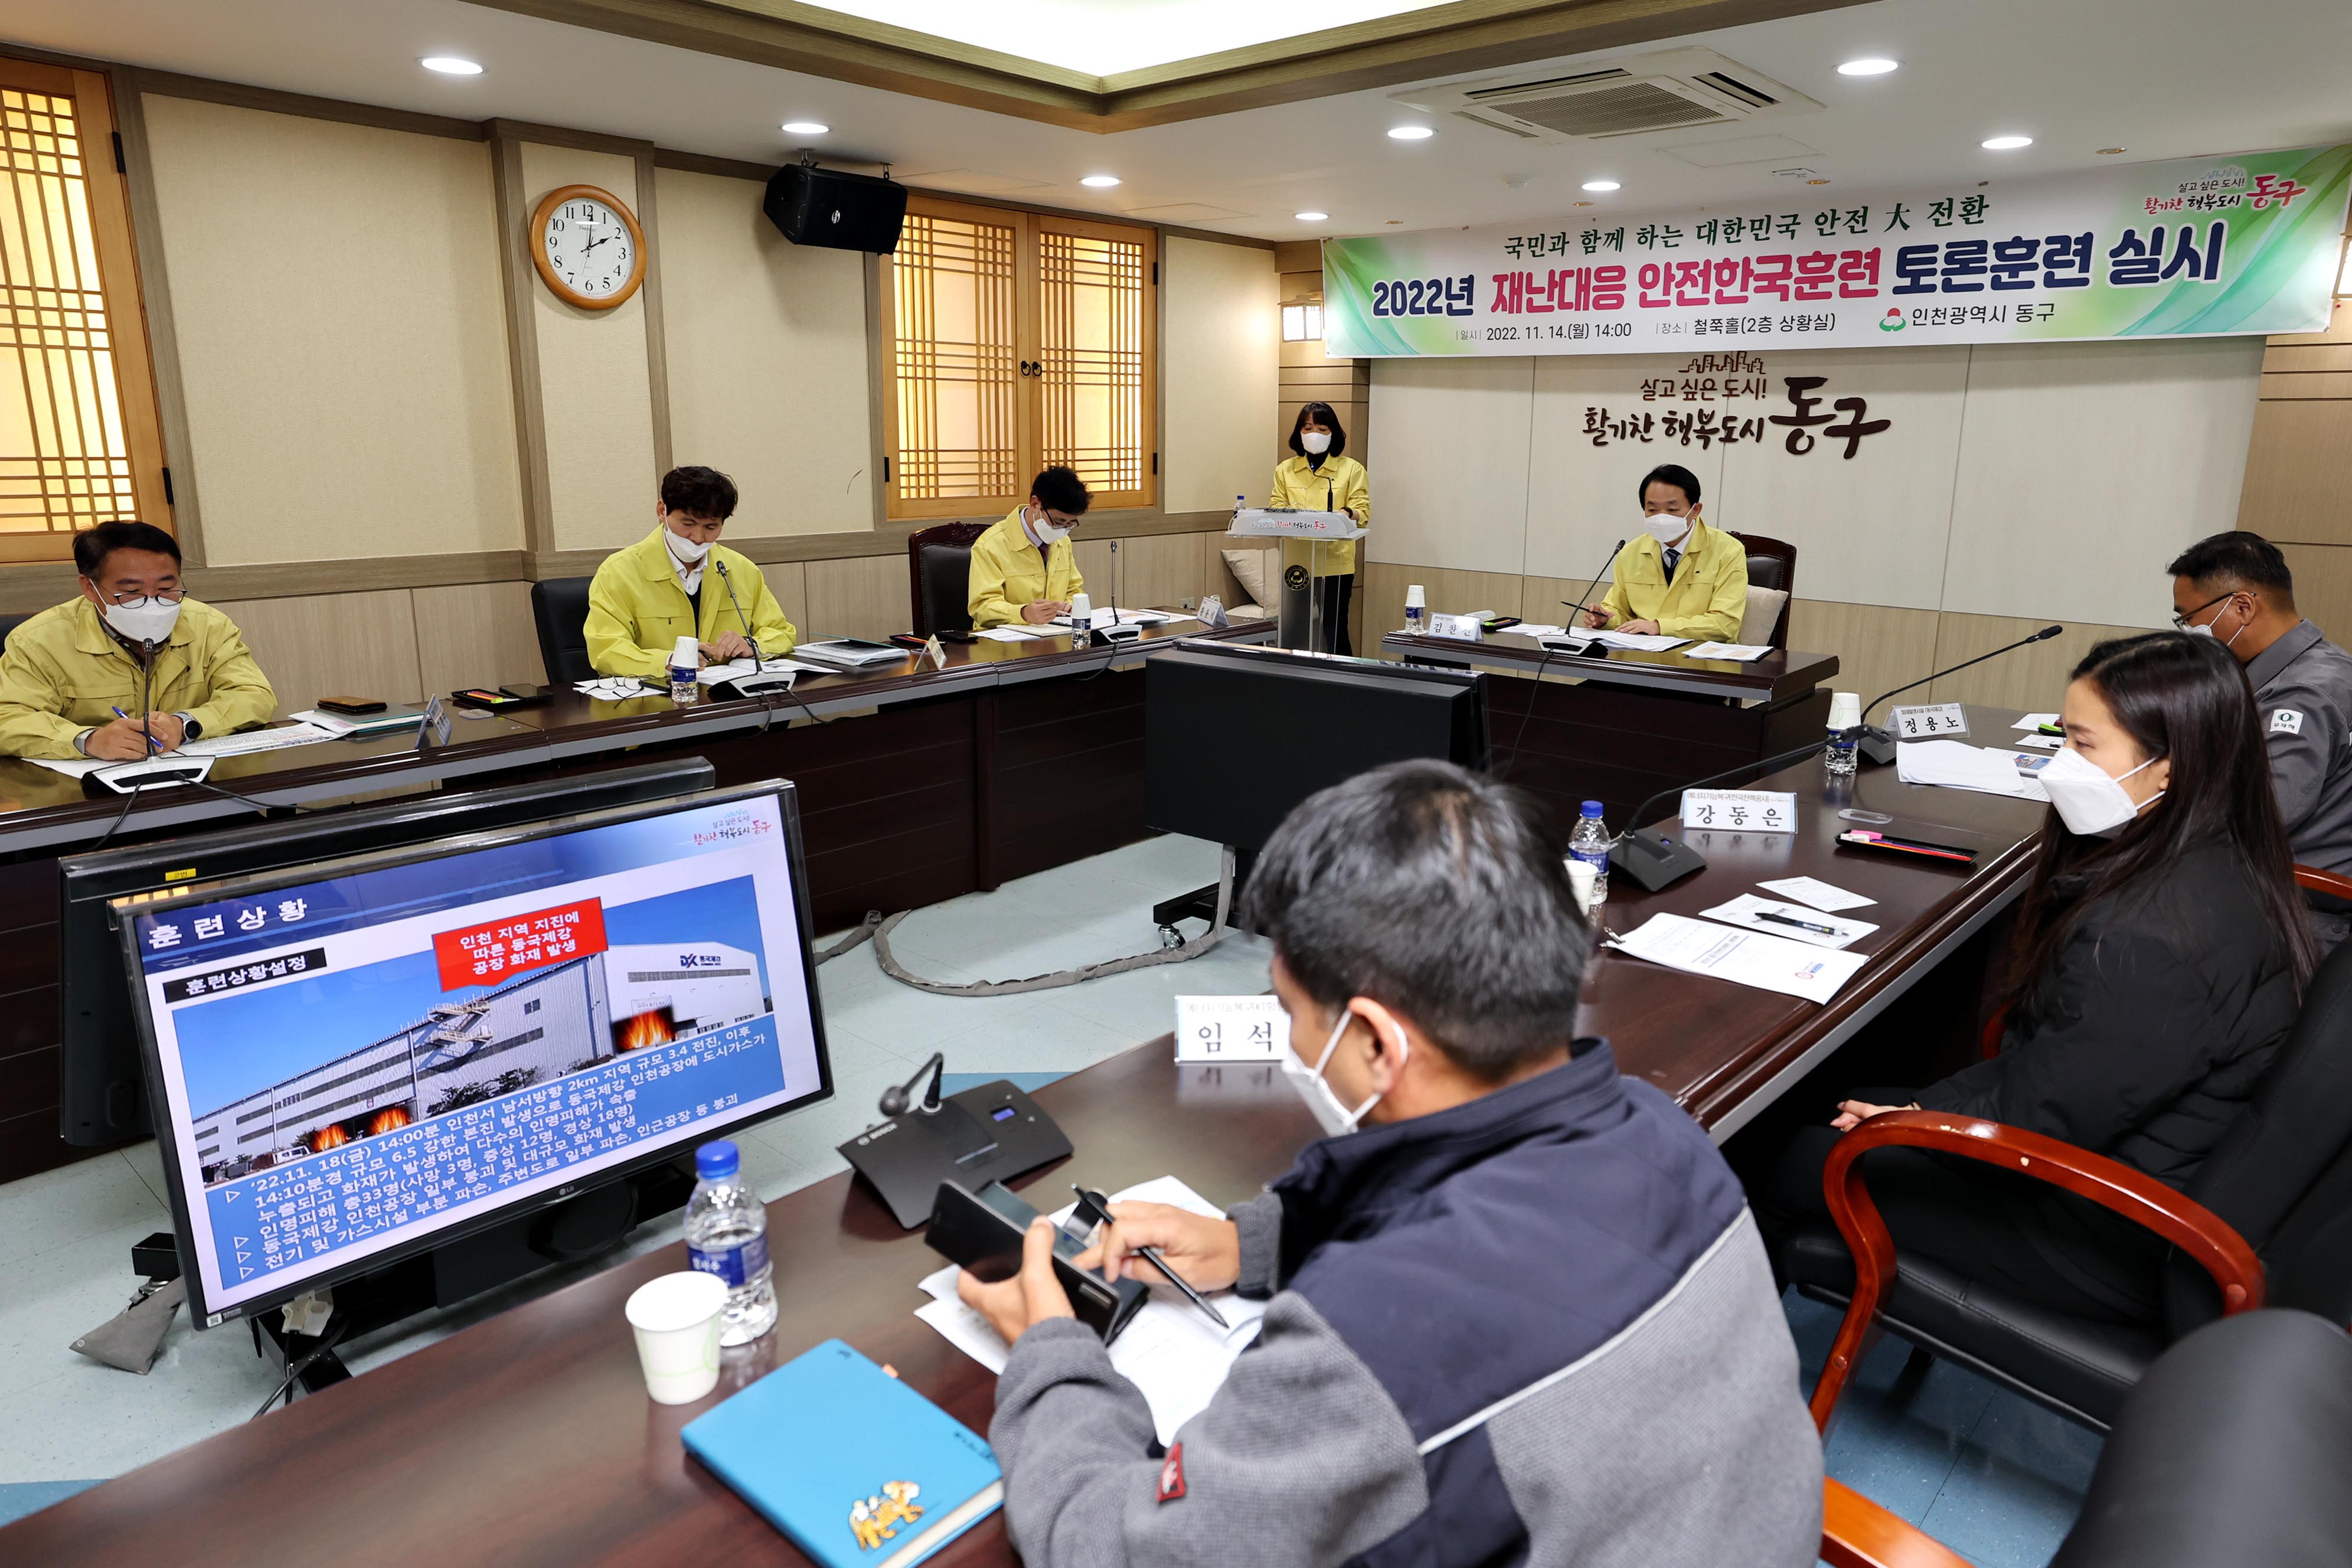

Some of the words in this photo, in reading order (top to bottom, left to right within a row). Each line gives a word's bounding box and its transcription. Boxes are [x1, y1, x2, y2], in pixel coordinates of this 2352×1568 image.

[2178, 182, 2197, 193] 살고
[2200, 181, 2219, 191] 싶은
[2222, 178, 2245, 188] 도시!
[2246, 175, 2306, 208] 동구
[566, 207, 574, 219] 11
[583, 205, 593, 217] 12
[2144, 197, 2183, 215] 활기찬
[2187, 194, 2241, 211] 행복도시
[553, 218, 564, 231] 10
[615, 227, 621, 239] 2
[1504, 232, 1570, 259] 국민과
[1580, 227, 1625, 255] 함께
[1636, 223, 1683, 250] 하는
[1696, 213, 1801, 246] 대한민국
[1814, 205, 1869, 237] 안전
[1884, 202, 1910, 233] 大
[1928, 194, 1990, 227] 전환
[550, 237, 557, 249] 9
[618, 247, 626, 260] 3
[554, 256, 563, 268] 8
[613, 264, 621, 276] 4
[1373, 274, 1474, 316] 2022년
[1491, 264, 1626, 315] 재난대응
[1638, 247, 1881, 308] 안전한국훈련
[1892, 231, 2093, 295] 토론훈련
[2108, 221, 2225, 286] 실시
[567, 272, 574, 284] 7
[586, 279, 593, 291] 6
[603, 277, 610, 289] 5
[1694, 316, 1772, 335] 철쭉홀(2층
[1779, 312, 1835, 332] 상황실)
[1911, 305, 2007, 327] 인천광역시
[2015, 303, 2055, 322] 동구
[1487, 327, 1520, 341] 2022.
[1525, 326, 1543, 339] 11.
[1549, 323, 1589, 339] 14.(월)
[1595, 323, 1631, 337] 14:00
[1639, 378, 1676, 401] 살고
[1680, 378, 1716, 401] 싶은
[1721, 377, 1767, 400] 도시!
[1582, 407, 1655, 446] 활기찬
[1661, 409, 1765, 450] 행복도시
[1768, 376, 1891, 459] 동구
[460, 932, 492, 949] 인천
[498, 923, 528, 938] 지역
[534, 911, 579, 930] 지진에
[473, 943, 505, 959] 따른
[511, 927, 571, 951] 동국제강
[473, 957, 504, 975] 공장
[510, 948, 540, 965] 화재
[547, 939, 576, 956] 발생
[186, 955, 306, 995] 훈련상황설정
[318, 1146, 371, 1172] 18(금)
[378, 1123, 440, 1152] 14:00분
[446, 1106, 495, 1132] 인천서
[501, 1084, 563, 1114] 남서방향
[567, 1076, 599, 1092] 2km
[603, 1063, 631, 1079] 지역
[636, 1053, 664, 1070] 규모
[668, 1046, 688, 1060] 3.4
[691, 1035, 721, 1053] 전진,
[726, 1026, 750, 1040] 이후
[254, 1170, 342, 1208] 14:10분경
[349, 1157, 386, 1178] 규모
[391, 1146, 417, 1163] 6.5
[423, 1133, 457, 1154] 강한
[463, 1121, 495, 1142] 본진
[501, 1100, 563, 1129] 발생으로
[567, 1079, 625, 1106] 동국제강
[631, 1054, 698, 1086] 인천공장에
[703, 1033, 766, 1062] 도시가스가
[258, 1188, 336, 1223] 누출되고
[341, 1167, 397, 1196] 화재가
[402, 1142, 470, 1176] 발생하여
[476, 1125, 524, 1149] 다수의
[529, 1099, 604, 1133] 인명피해가
[609, 1089, 637, 1105] 속출
[259, 1203, 337, 1240] 인명피해
[447, 1157, 477, 1174] 3명,
[520, 1129, 557, 1149] 12명,
[563, 1116, 593, 1135] 경상
[597, 1103, 633, 1123] 18명)
[262, 1217, 339, 1254] 동국제강
[346, 1190, 417, 1225] 인천공장
[423, 1177, 458, 1198] 일부
[502, 1155, 518, 1171] 및
[522, 1139, 569, 1162] 대규모
[573, 1126, 603, 1146] 화재
[608, 1115, 636, 1134] 발생
[264, 1246, 303, 1270] 전기
[311, 1236, 330, 1254] 및
[337, 1208, 409, 1243] 가스시설
[415, 1194, 449, 1215] 부분
[455, 1182, 492, 1201] 파손,
[498, 1157, 560, 1186] 주변도로
[565, 1143, 594, 1163] 일부
[599, 1133, 632, 1149] 파손,
[636, 1110, 691, 1138] 인근공장
[695, 1103, 708, 1116] 등
